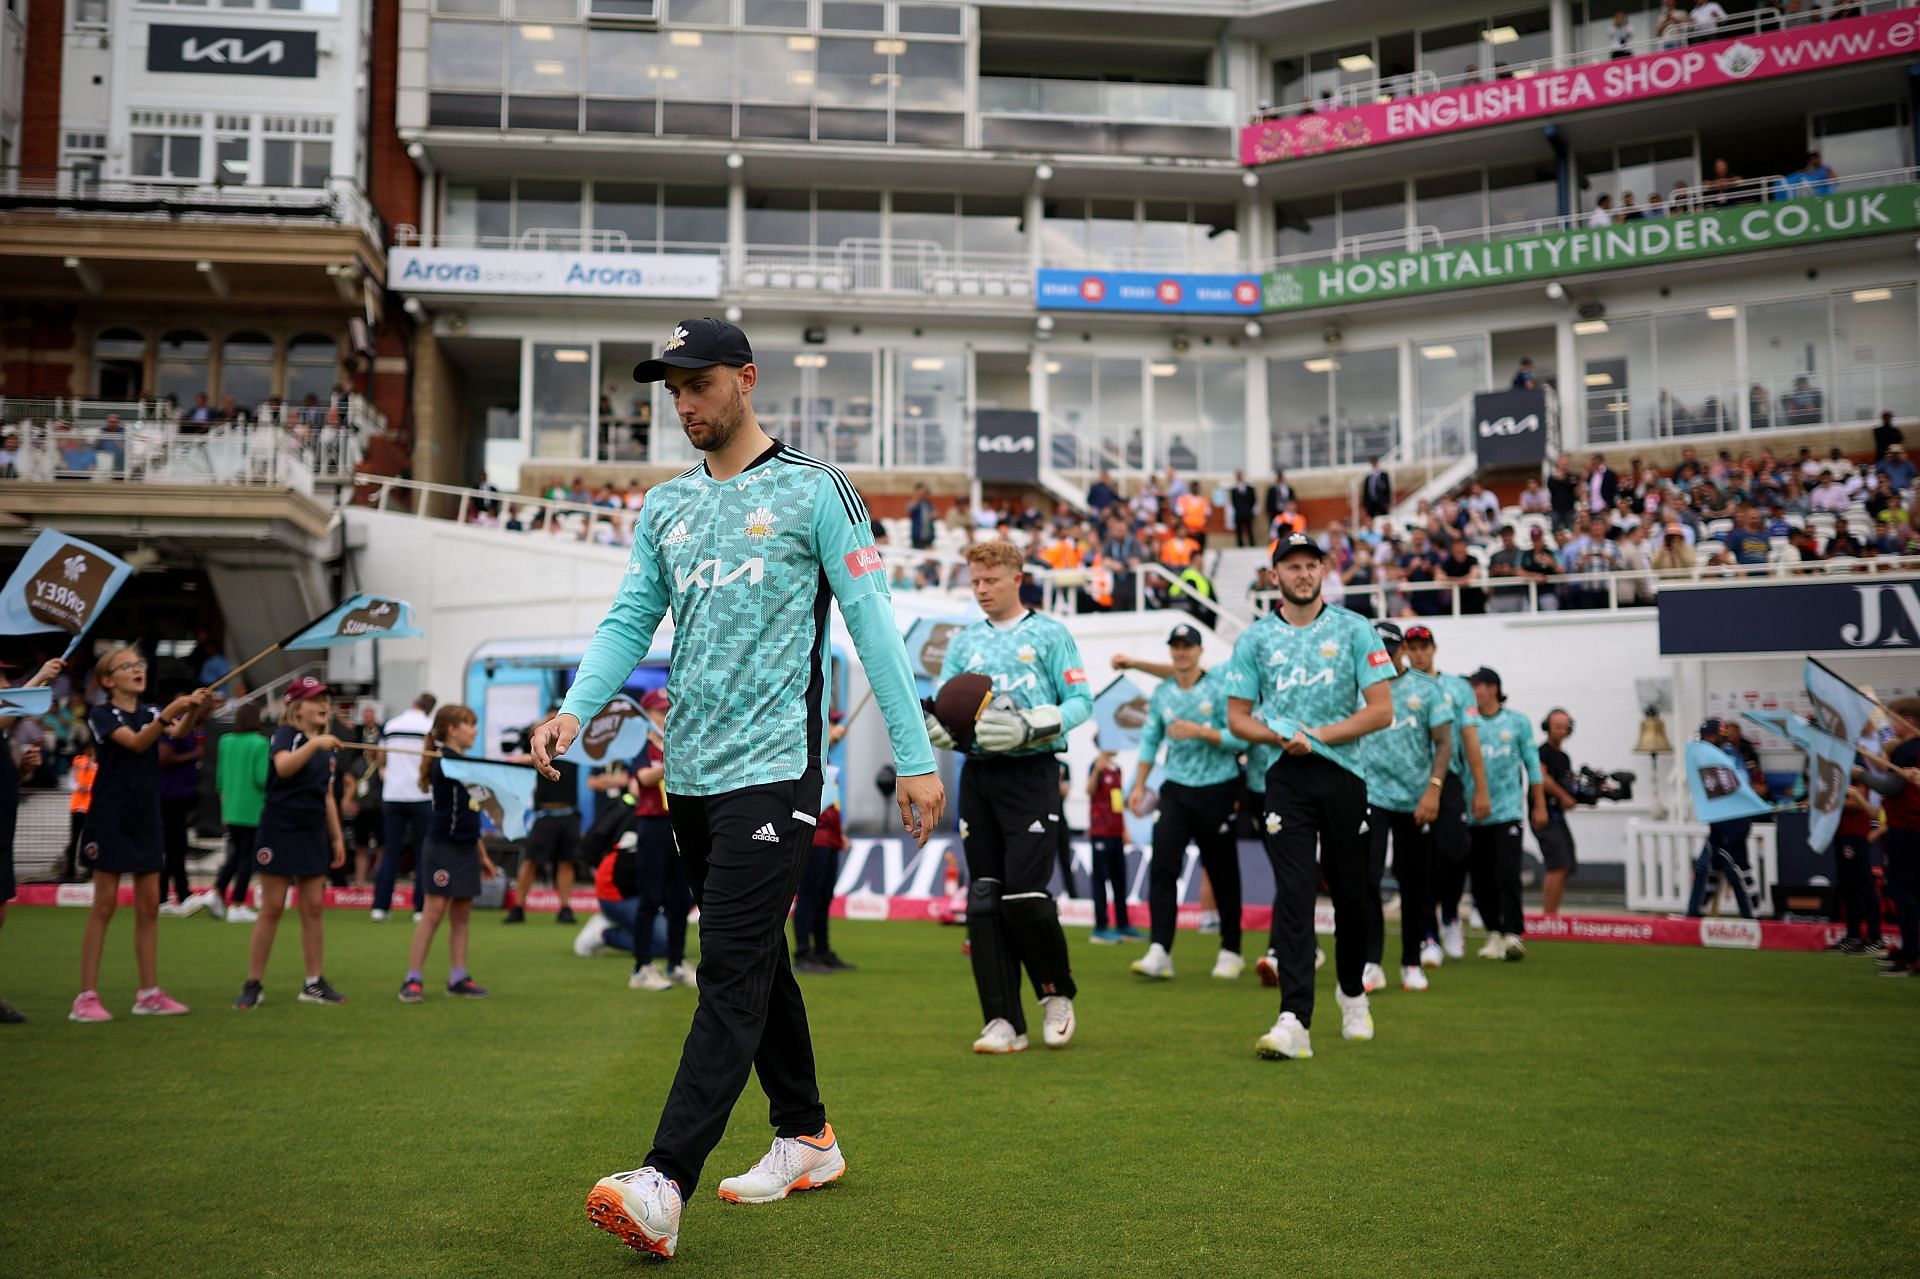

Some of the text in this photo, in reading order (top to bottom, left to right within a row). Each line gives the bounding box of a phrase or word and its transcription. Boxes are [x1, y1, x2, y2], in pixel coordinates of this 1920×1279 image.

[181, 37, 285, 65] KIA
[1386, 12, 1920, 136] ENGLISH TEA SHOP www.e
[1318, 193, 1891, 299] HOSPITALITYFINDER.CO.UK
[402, 257, 481, 284] Arora
[566, 262, 642, 286] Arora
[1479, 413, 1539, 438] KIA
[978, 434, 1035, 453] KIA
[664, 533, 692, 546] adidas
[674, 558, 764, 593] KIA
[1276, 667, 1334, 692] KIA
[751, 833, 780, 843] adidas
[1526, 916, 1654, 939] ealth insurance
